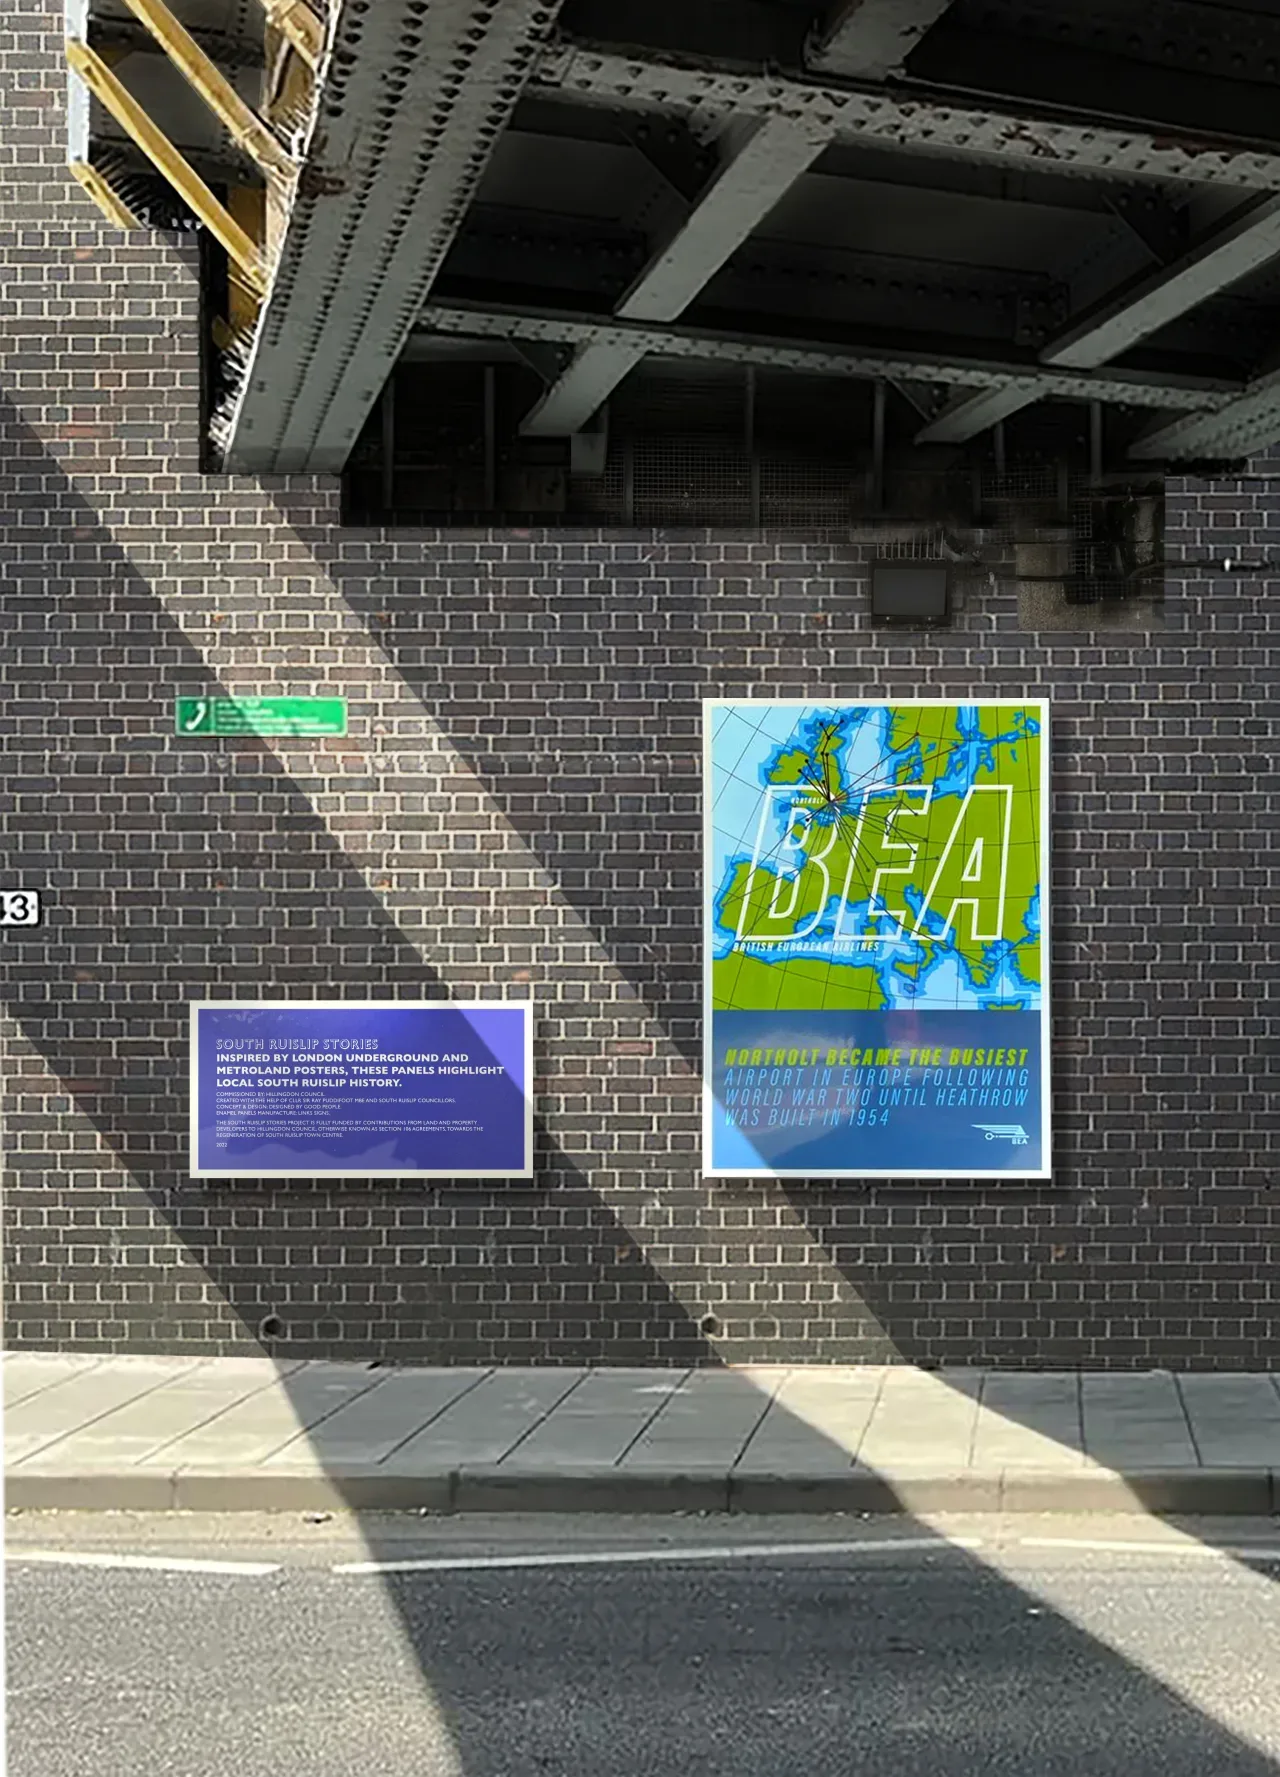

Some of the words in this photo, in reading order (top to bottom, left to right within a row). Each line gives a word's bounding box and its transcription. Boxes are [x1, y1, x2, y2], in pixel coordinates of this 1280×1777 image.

[736, 785, 1013, 940] BEA
[733, 941, 773, 951] BRITISH
[777, 941, 828, 951] EUROPEAN
[832, 941, 879, 951] AIRLINES
[216, 1039, 264, 1050] SOUTH
[269, 1039, 319, 1050] RUISLIP
[323, 1039, 378, 1050] STORIES
[216, 1054, 270, 1063] INSPIRED
[274, 1054, 289, 1063] BY
[292, 1054, 342, 1063] LONDON
[347, 1054, 438, 1063] UNDERGROUND
[442, 1054, 469, 1063] AND
[725, 1049, 819, 1066] NORTHOLT
[827, 1049, 900, 1066] BECAME
[909, 1049, 943, 1066] THE
[951, 1049, 1028, 1066] BUSIEST
[216, 1066, 290, 1075] METROLAND
[294, 1066, 349, 1076] POSTERS,
[352, 1066, 388, 1075] THESE
[392, 1066, 434, 1075] PANELS
[438, 1066, 504, 1075] HIGHLIGHT
[725, 1069, 803, 1086] AIRPORT
[813, 1069, 831, 1086] IN
[843, 1069, 912, 1086] EUROPE
[922, 1069, 1029, 1086] FOLLOWING
[216, 1078, 253, 1087] LOCAL
[257, 1078, 298, 1087] SOUTH
[302, 1078, 346, 1087] RUISLIP
[350, 1078, 402, 1087] HISTORY.
[725, 1089, 782, 1106] WORLD
[792, 1089, 827, 1106] WAR
[837, 1089, 871, 1106] TWO
[880, 1089, 927, 1106] UNTIL
[936, 1089, 1029, 1106] HEATHROW
[725, 1109, 759, 1126] WAS
[768, 1109, 814, 1126] BUILT
[824, 1109, 842, 1126] IN
[850, 1109, 889, 1126] 1954
